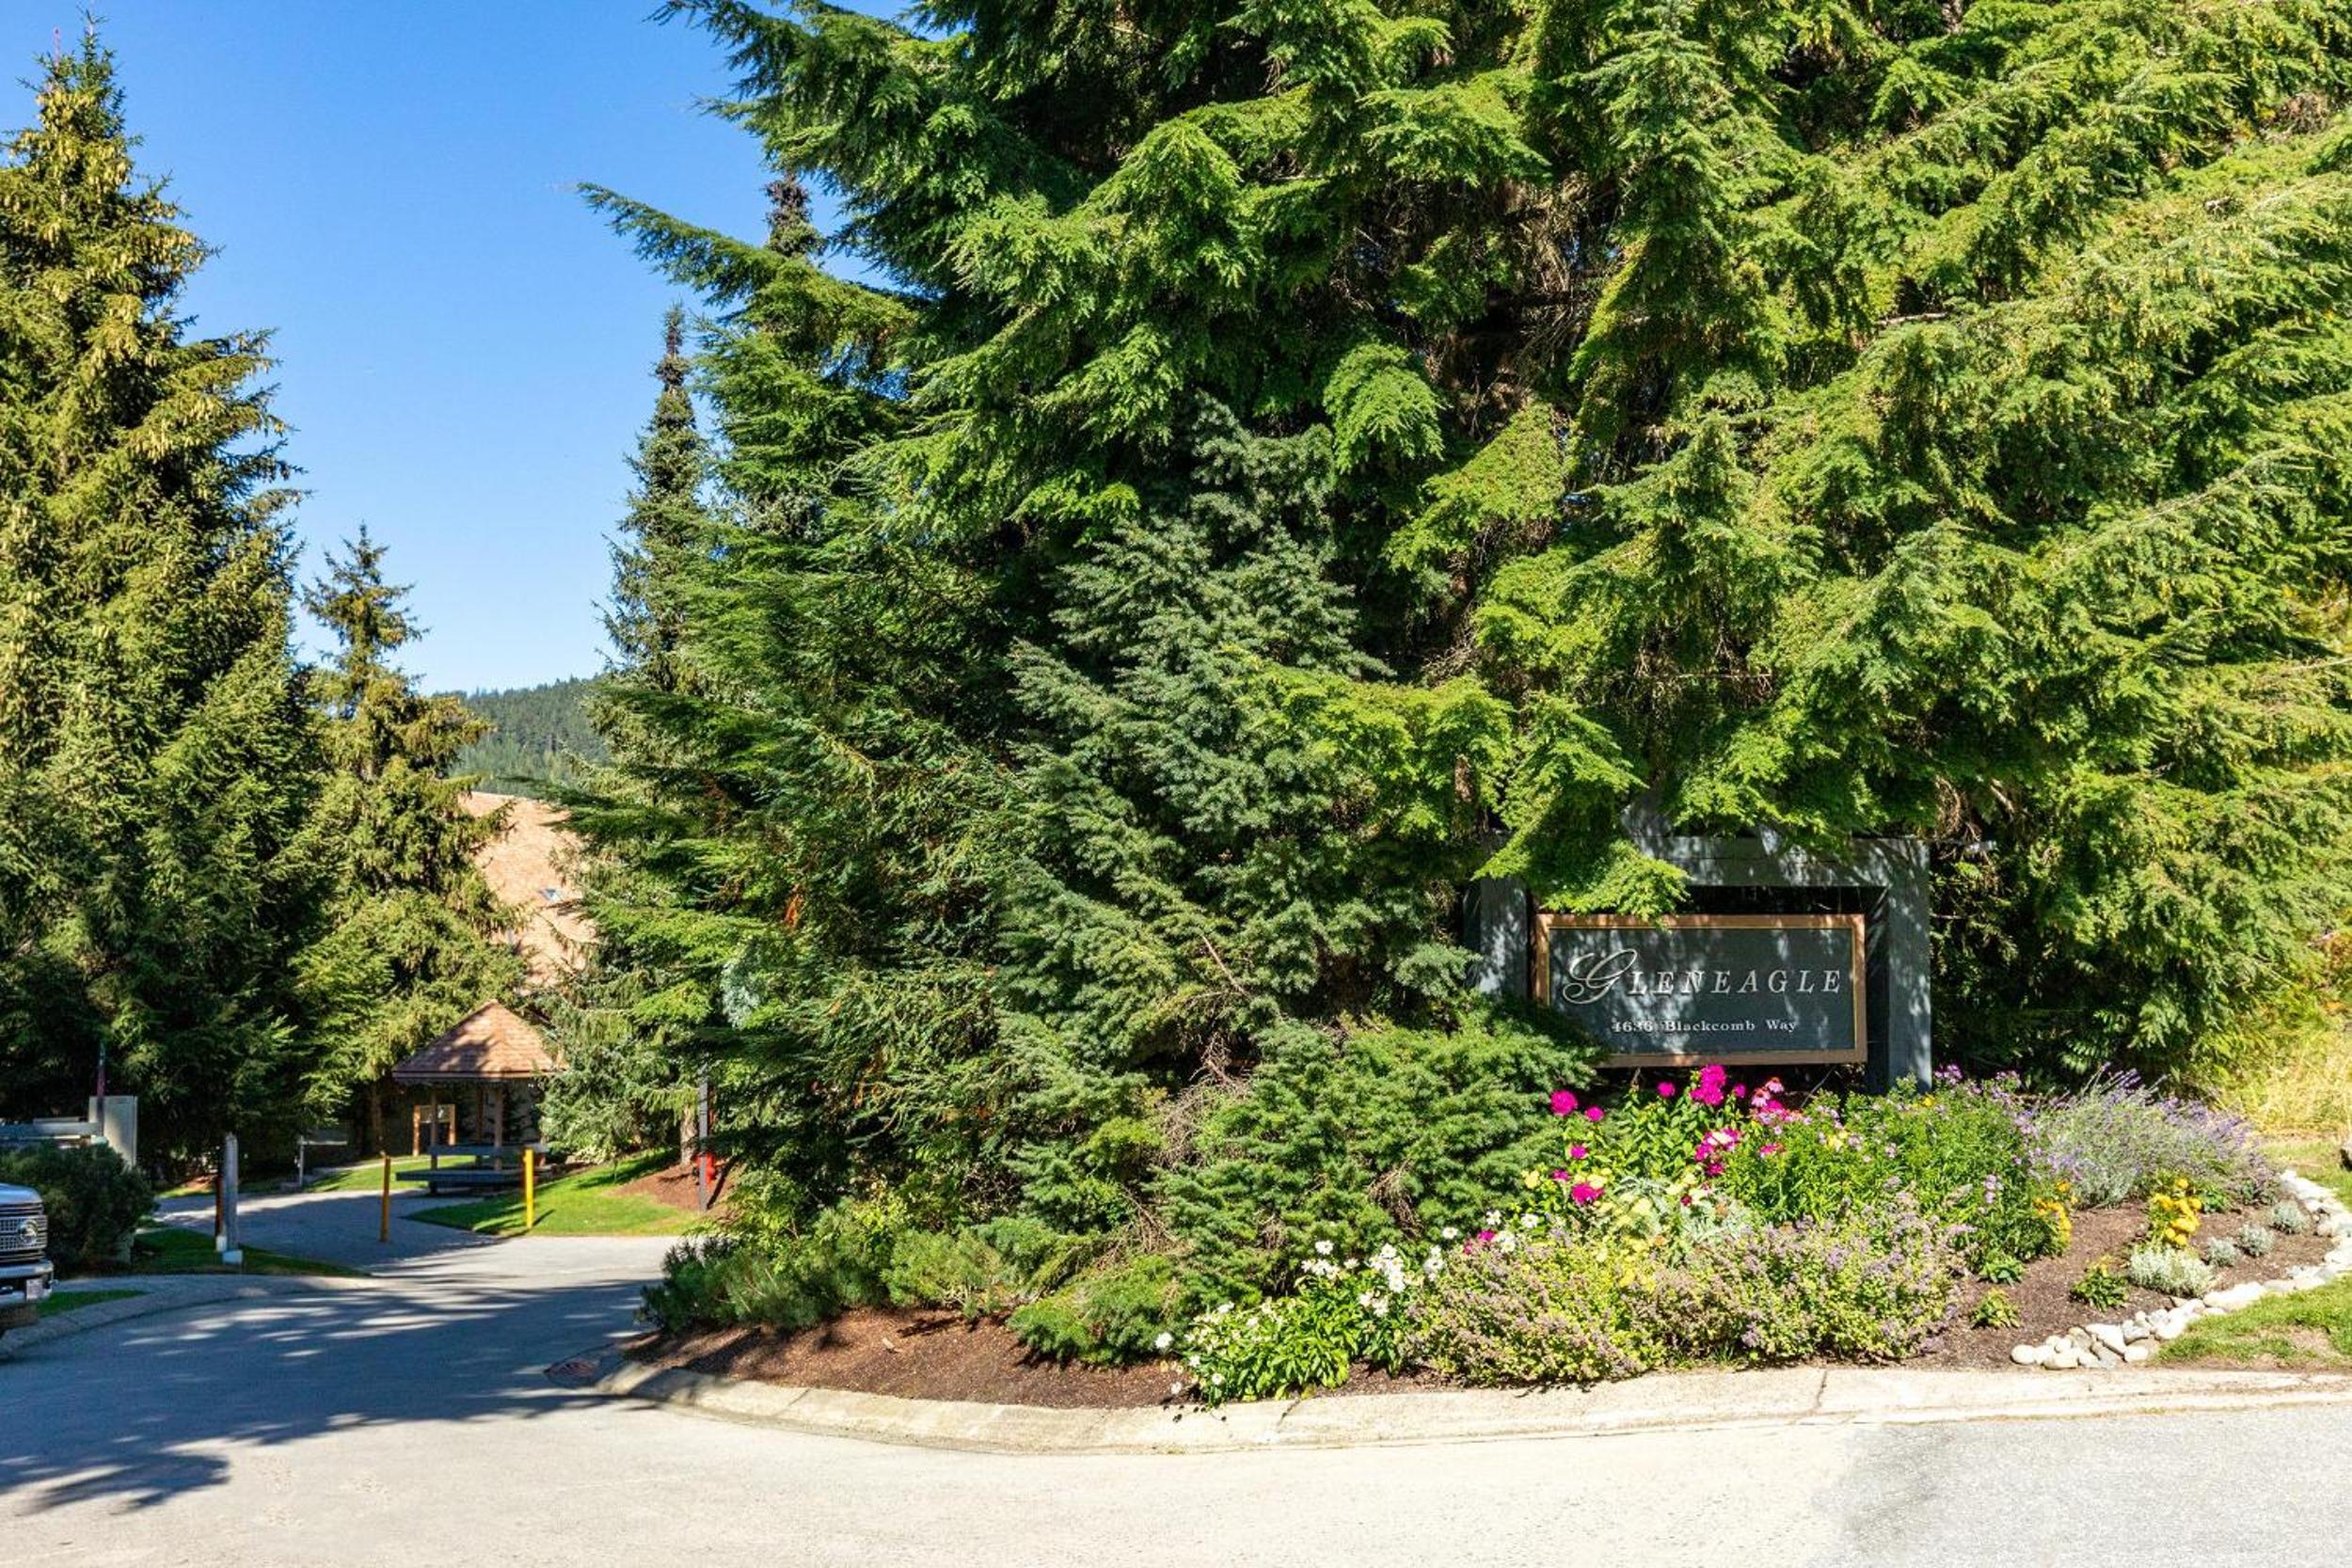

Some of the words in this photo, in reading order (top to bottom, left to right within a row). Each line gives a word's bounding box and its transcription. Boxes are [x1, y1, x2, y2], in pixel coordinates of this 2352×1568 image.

[1563, 949, 1840, 1005] GLENEAGLE
[1664, 1019, 1756, 1033] Blackcomb
[1766, 1019, 1797, 1034] Way
